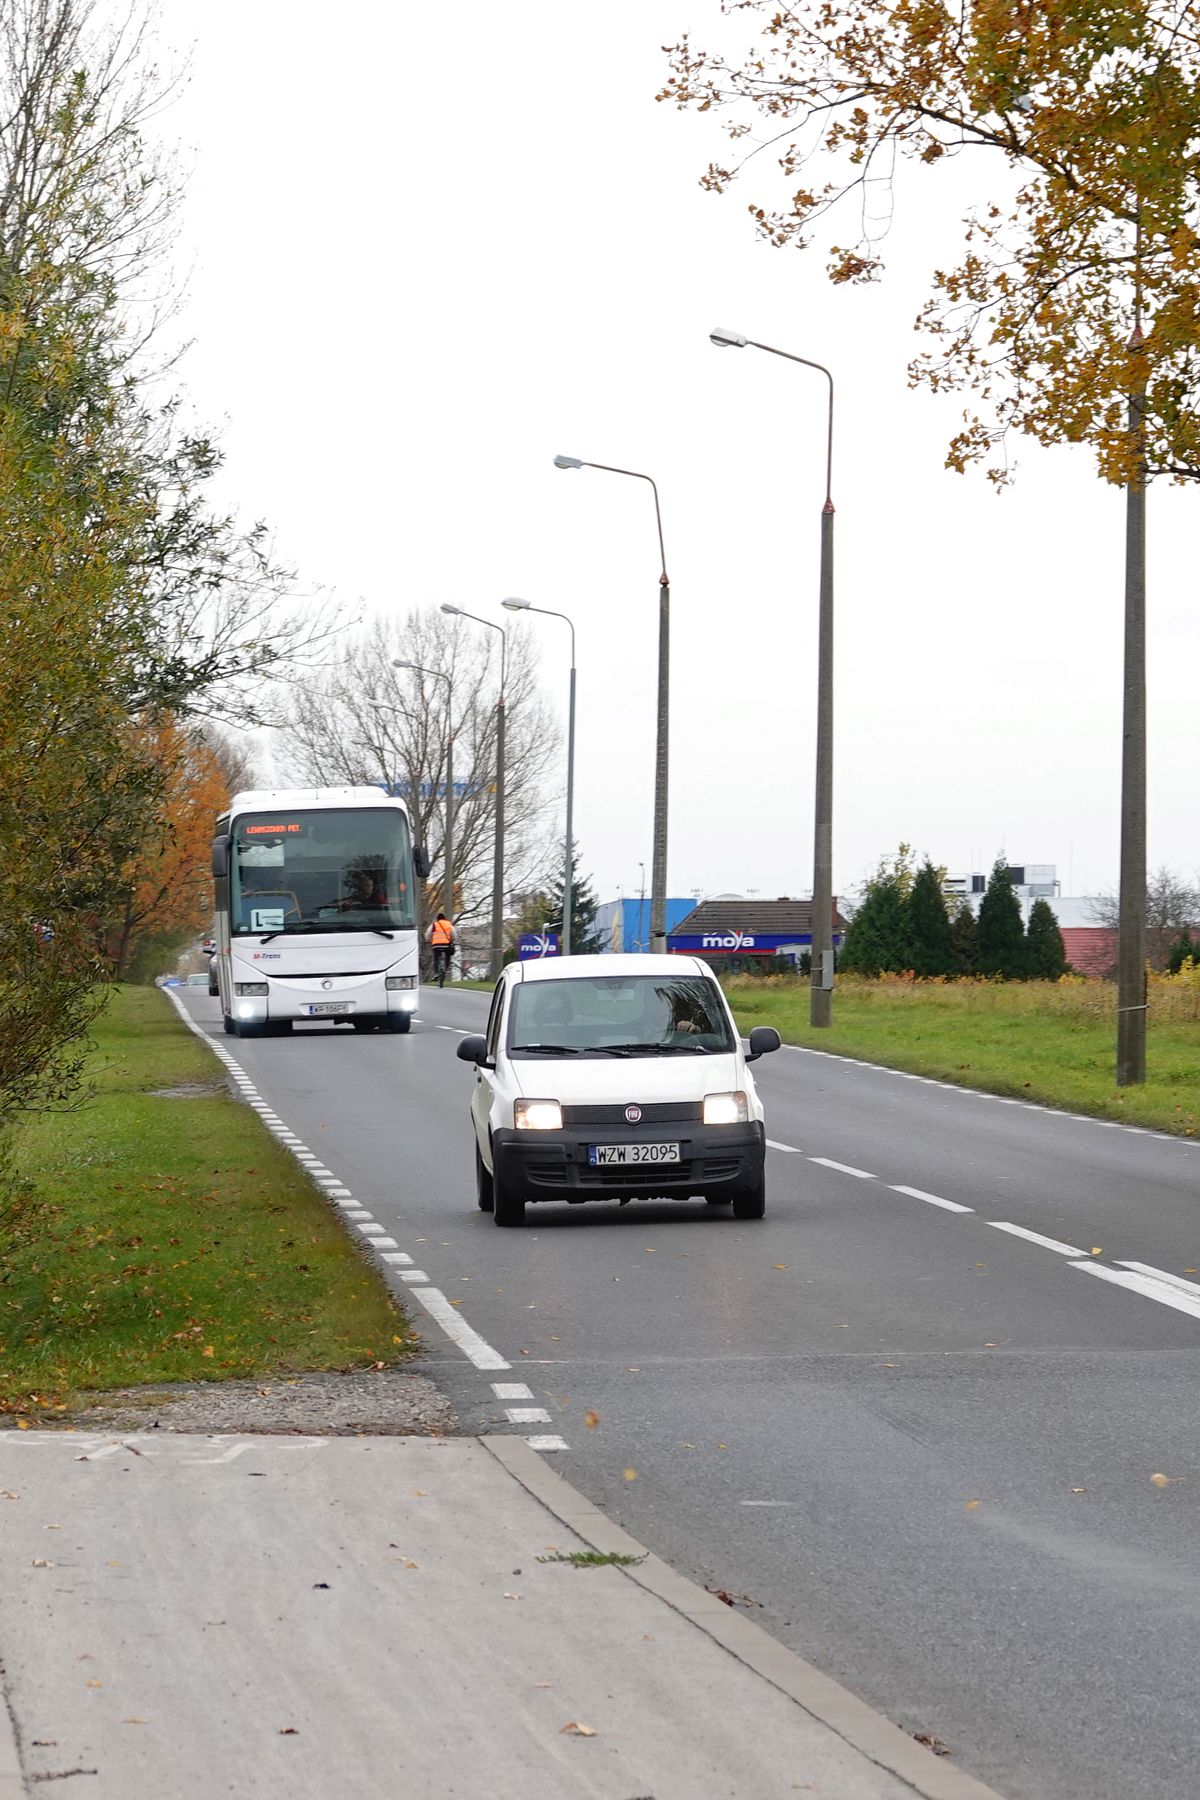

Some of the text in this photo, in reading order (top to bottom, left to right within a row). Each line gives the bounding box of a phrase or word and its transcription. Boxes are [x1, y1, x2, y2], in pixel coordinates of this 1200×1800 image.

[520, 935, 557, 959] moya
[702, 929, 755, 952] moya
[597, 1145, 678, 1163] WZW 32095
